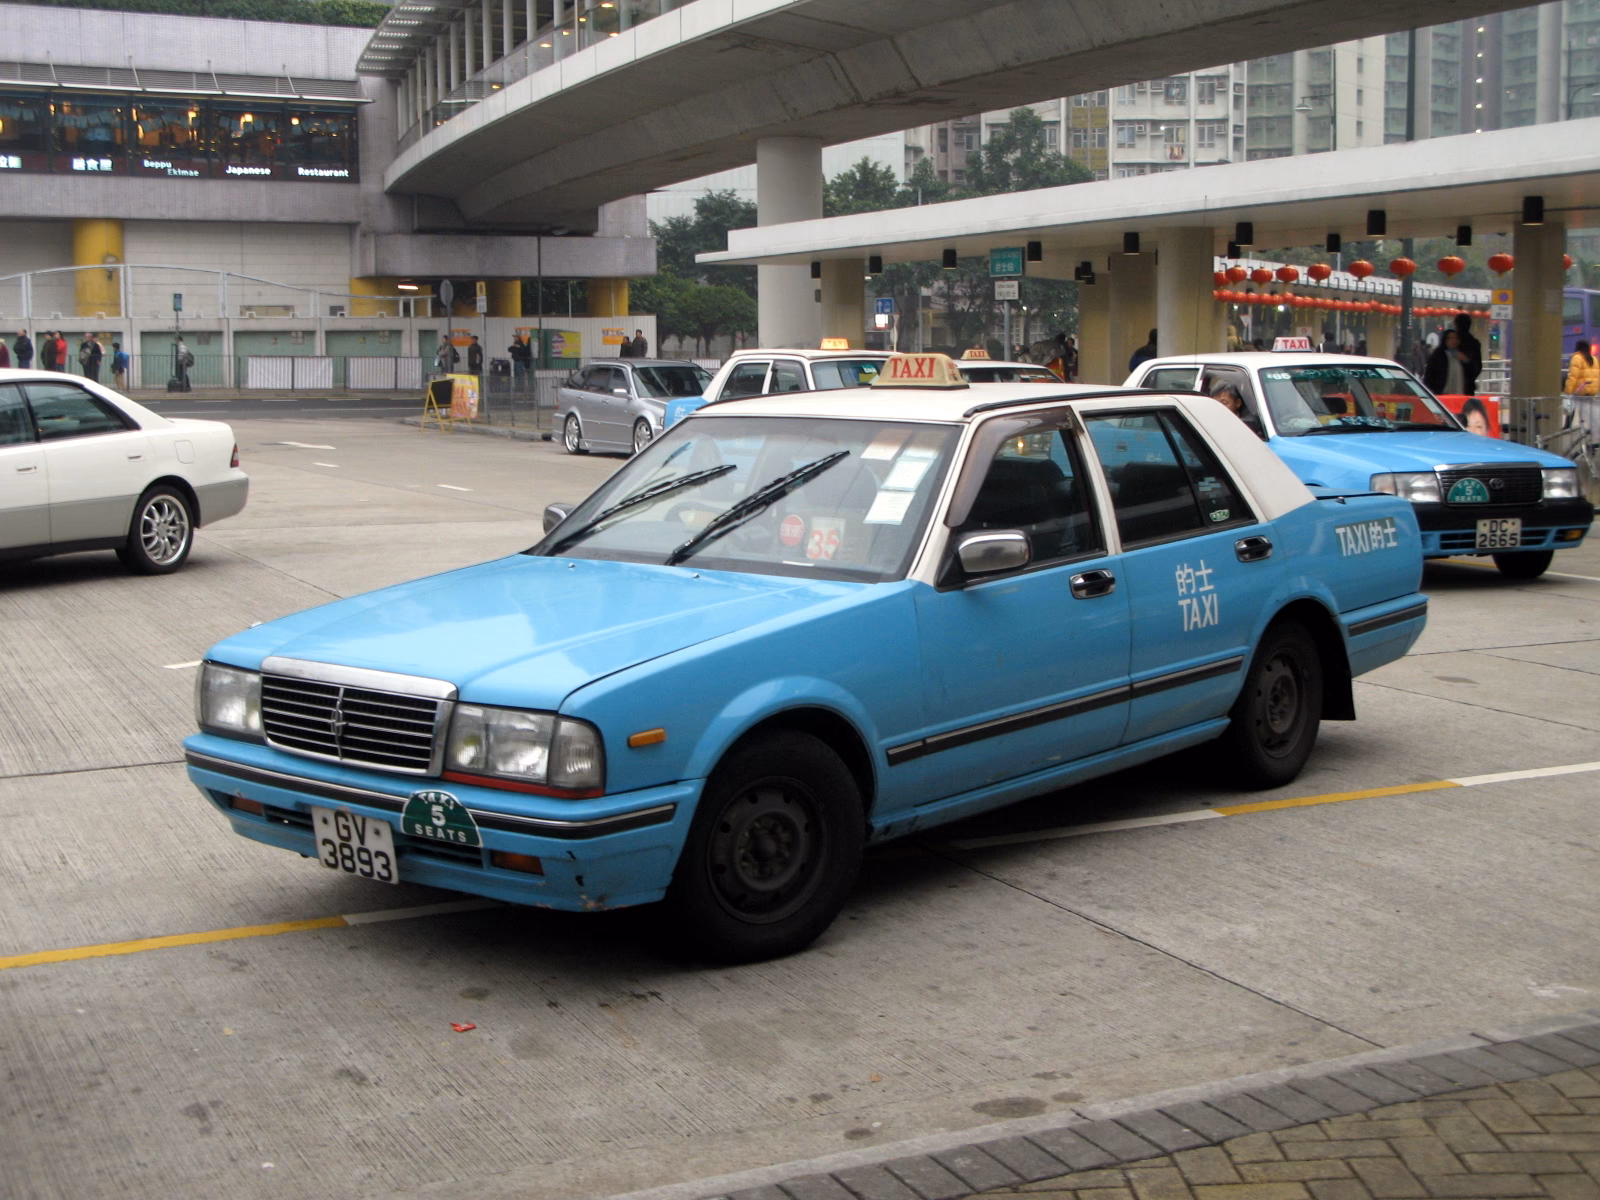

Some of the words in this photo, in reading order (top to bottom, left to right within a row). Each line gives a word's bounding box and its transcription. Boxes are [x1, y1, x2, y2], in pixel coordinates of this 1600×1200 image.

[143, 159, 172, 169] Beppu
[167, 168, 200, 176] Ekimae
[225, 165, 272, 176] Japanese
[297, 166, 349, 177] Restaurant
[1282, 339, 1307, 349] TAXI
[890, 357, 937, 379] TAXI
[1457, 481, 1480, 489] TAXI
[1465, 485, 1473, 496] 5
[1489, 520, 1509, 533] DC
[1478, 533, 1518, 547] 2665
[1175, 559, 1215, 597] 的士
[1178, 593, 1218, 632] TAXI
[417, 792, 455, 811] TAXI
[431, 804, 447, 827] 5
[334, 810, 366, 846] GV
[414, 823, 467, 843] SEATS
[321, 838, 392, 882] 3893
